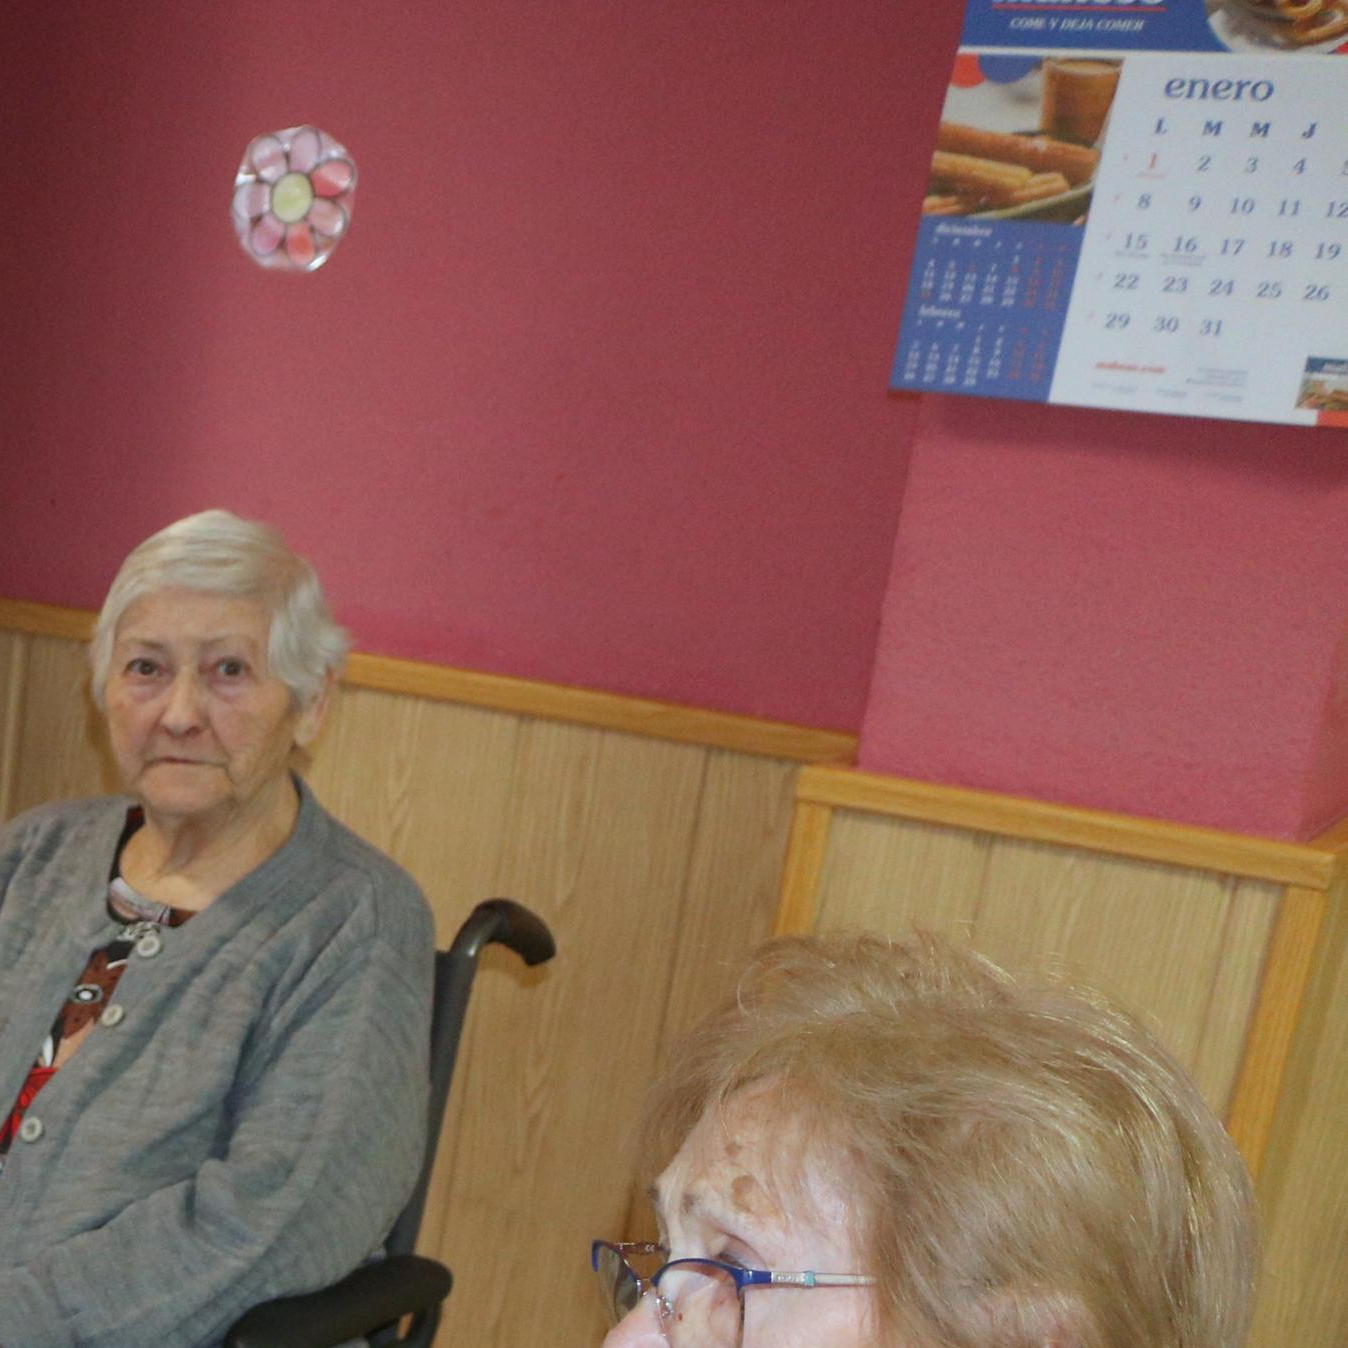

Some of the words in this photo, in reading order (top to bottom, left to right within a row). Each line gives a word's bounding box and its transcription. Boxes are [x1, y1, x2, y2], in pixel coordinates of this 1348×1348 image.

[1009, 17, 1046, 30] COME
[1049, 17, 1059, 31] Y
[1059, 18, 1094, 31] DEJA
[1096, 18, 1145, 32] COMER
[1164, 78, 1274, 101] enero
[1154, 117, 1168, 135] L
[1202, 119, 1224, 138] M
[1250, 121, 1272, 139] M
[1301, 121, 1318, 140] J
[1148, 152, 1158, 169] 1
[1197, 154, 1212, 172] 2
[1245, 156, 1259, 174] 3
[1293, 157, 1307, 175] 4
[1137, 192, 1152, 210] 8
[1188, 195, 1202, 212] 9
[1230, 197, 1256, 215] 10
[1278, 199, 1302, 217] 11
[1124, 232, 1148, 250] 15
[1174, 236, 1198, 253] 16
[1220, 238, 1246, 256] 17
[1267, 240, 1294, 258] 18
[1315, 242, 1342, 260] 19
[1112, 272, 1140, 290] 22
[1162, 276, 1189, 293] 23
[1209, 278, 1235, 296] 24
[1256, 281, 1283, 299] 25
[1304, 284, 1331, 301] 26
[1105, 312, 1131, 329] 29
[1154, 315, 1180, 333] 30
[1200, 318, 1224, 337] 31
